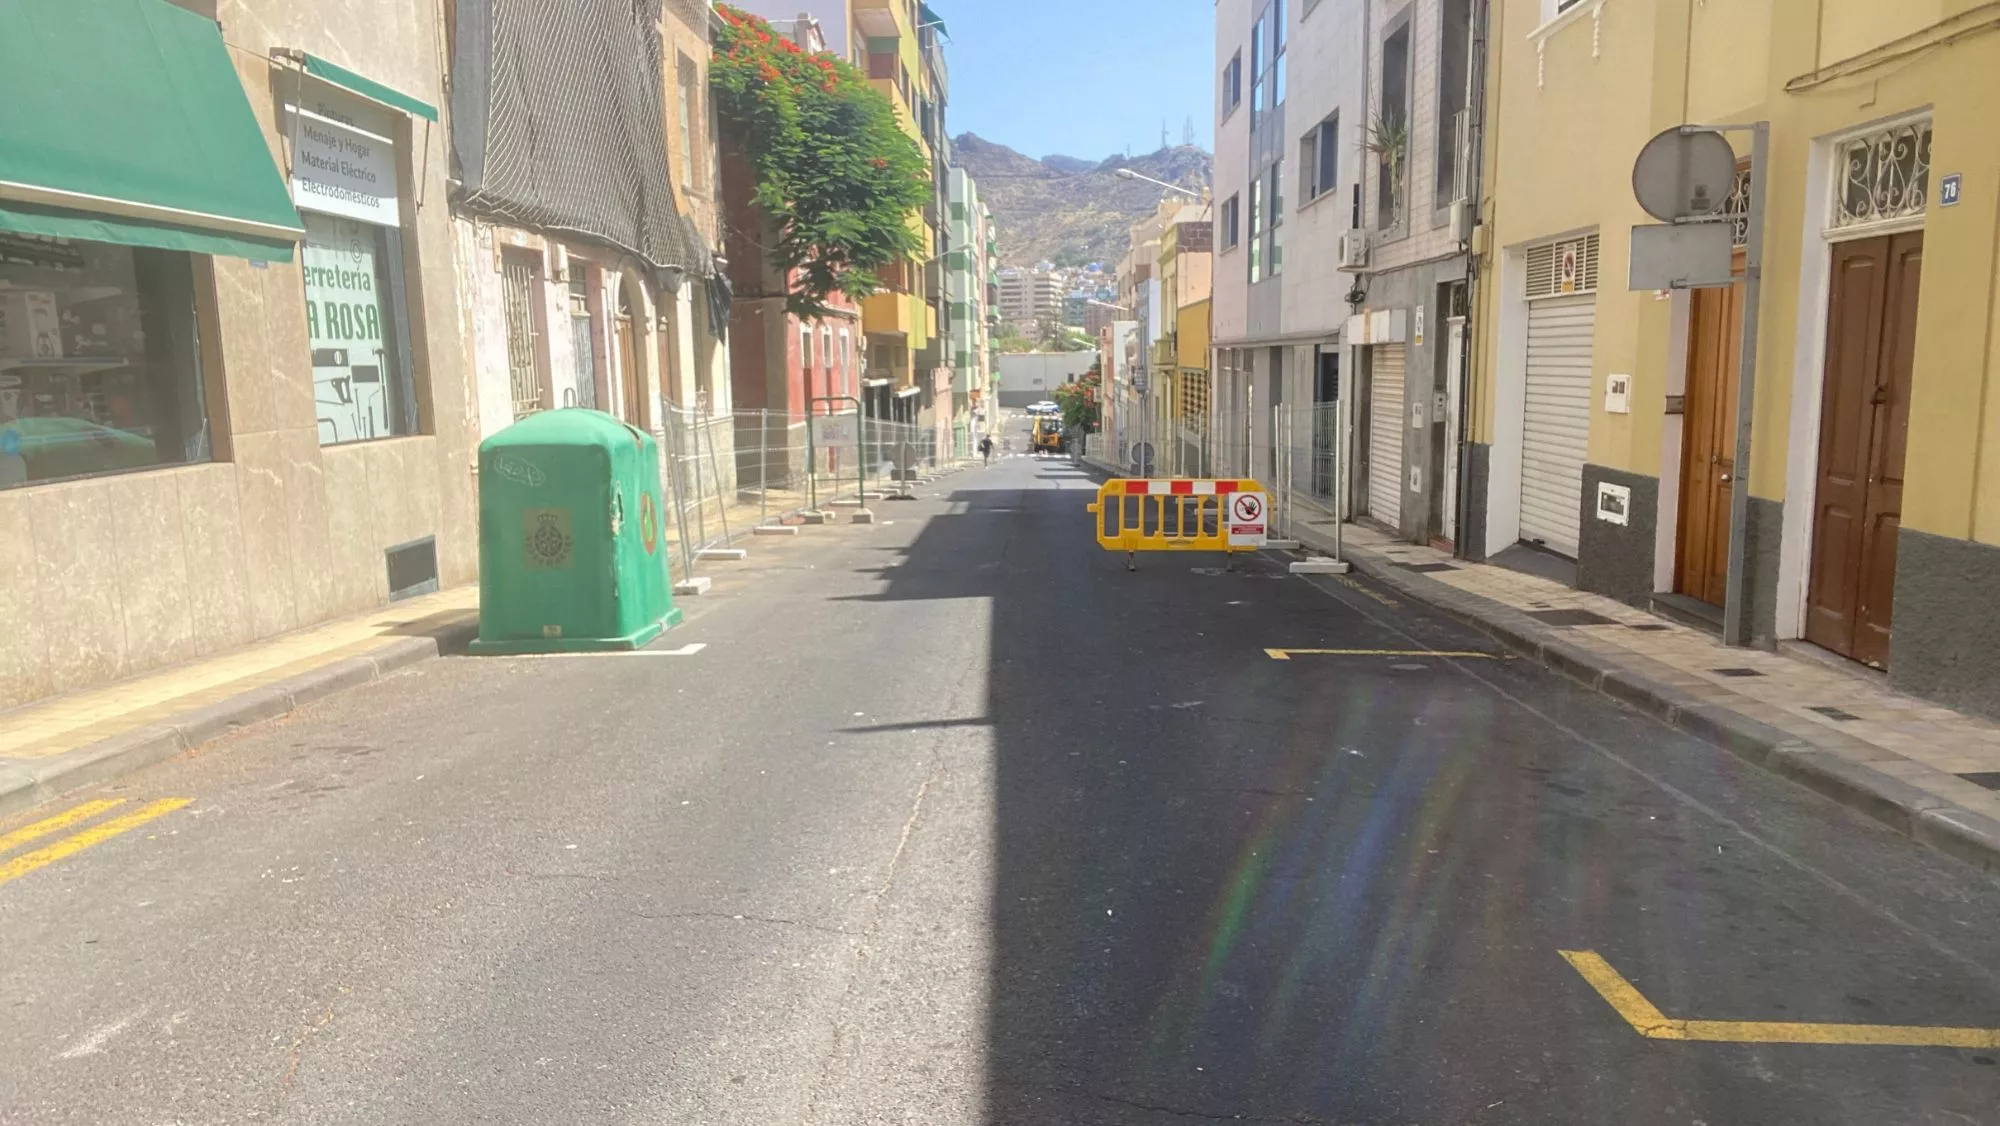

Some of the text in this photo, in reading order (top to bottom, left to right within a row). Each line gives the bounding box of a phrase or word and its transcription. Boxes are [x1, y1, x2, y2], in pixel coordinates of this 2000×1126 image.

[303, 124, 371, 159] Menaje y Hogar
[301, 149, 377, 184] Material Eléctrico
[302, 176, 380, 208] Electrodomésticos
[1944, 181, 1957, 199] 76
[304, 264, 372, 291] erretería
[307, 300, 380, 340] A ROSA
